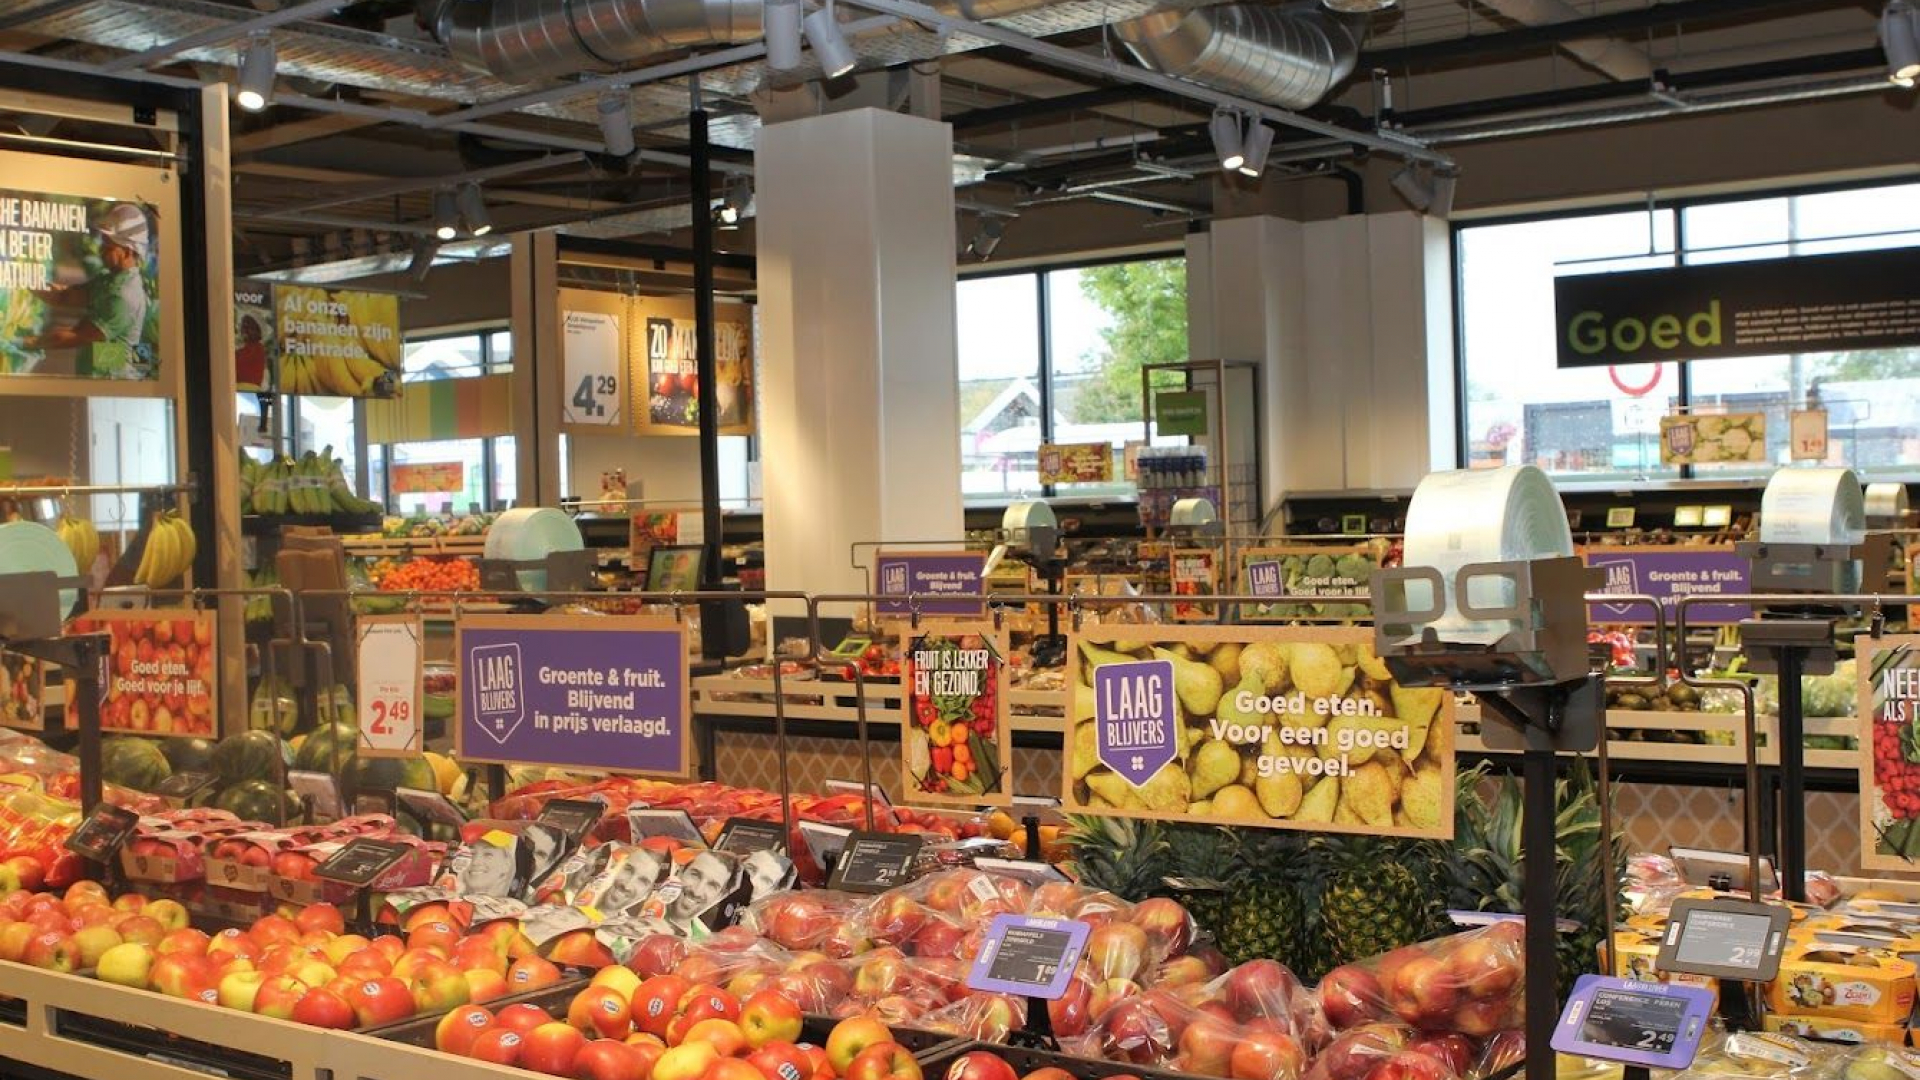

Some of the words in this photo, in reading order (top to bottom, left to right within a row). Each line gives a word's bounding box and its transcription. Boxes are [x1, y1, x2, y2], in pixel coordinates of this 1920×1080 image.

[22, 199, 90, 234] BANANEN.
[9, 230, 54, 261] BETER
[235, 291, 264, 304] voor
[284, 294, 302, 313] Al
[307, 299, 348, 316] onze
[284, 315, 358, 337] bananen
[363, 323, 392, 342] zijn
[1568, 299, 1723, 355] Goed
[285, 337, 368, 358] Fairtrade.
[650, 323, 669, 359] ZO
[573, 375, 616, 417] 4.29
[916, 570, 948, 581] Groente
[929, 580, 963, 592] Blijvend
[1252, 565, 1277, 585] LAAG
[1302, 576, 1330, 586] Goed
[1331, 577, 1358, 587] eten.
[1606, 565, 1631, 585] AAG
[1648, 570, 1698, 582] Groente
[1701, 571, 1709, 581] &
[1712, 570, 1743, 582] fruit.
[1290, 587, 1317, 597] Goed
[1318, 589, 1343, 597] voor
[1671, 582, 1721, 596] Blijvend
[131, 659, 160, 675] Goed
[161, 660, 189, 675] eten.
[914, 650, 940, 669] FRUIT
[942, 650, 952, 669] IS
[954, 650, 988, 669] LEKKER
[479, 655, 514, 692] LAAG
[539, 666, 604, 686] Groente
[607, 668, 619, 686] &
[624, 668, 666, 688] fruit.
[914, 671, 930, 695] EN
[934, 671, 982, 696] GEZOND.
[1883, 667, 1920, 699] NEE
[117, 677, 145, 692] Goed
[147, 681, 173, 693] voor
[173, 679, 184, 698] je
[186, 679, 205, 698] lijf.
[1106, 674, 1163, 720] LAAG
[480, 690, 516, 712] BLIJVERS
[568, 689, 635, 711] Blijvend
[1235, 690, 1306, 715] Goed
[1313, 693, 1382, 717] eten.
[1883, 700, 1905, 722] ALS
[369, 700, 410, 734] 2.49
[534, 711, 550, 729] in
[553, 712, 588, 734] prijs
[592, 714, 671, 738] verlaagd.
[1107, 720, 1165, 747] BLIJVERS
[1209, 719, 1273, 744] Voor
[1279, 725, 1329, 745] een
[1337, 725, 1409, 751] goed
[1257, 753, 1356, 778] gevoel.
[1636, 1030, 1675, 1050] 2.49
